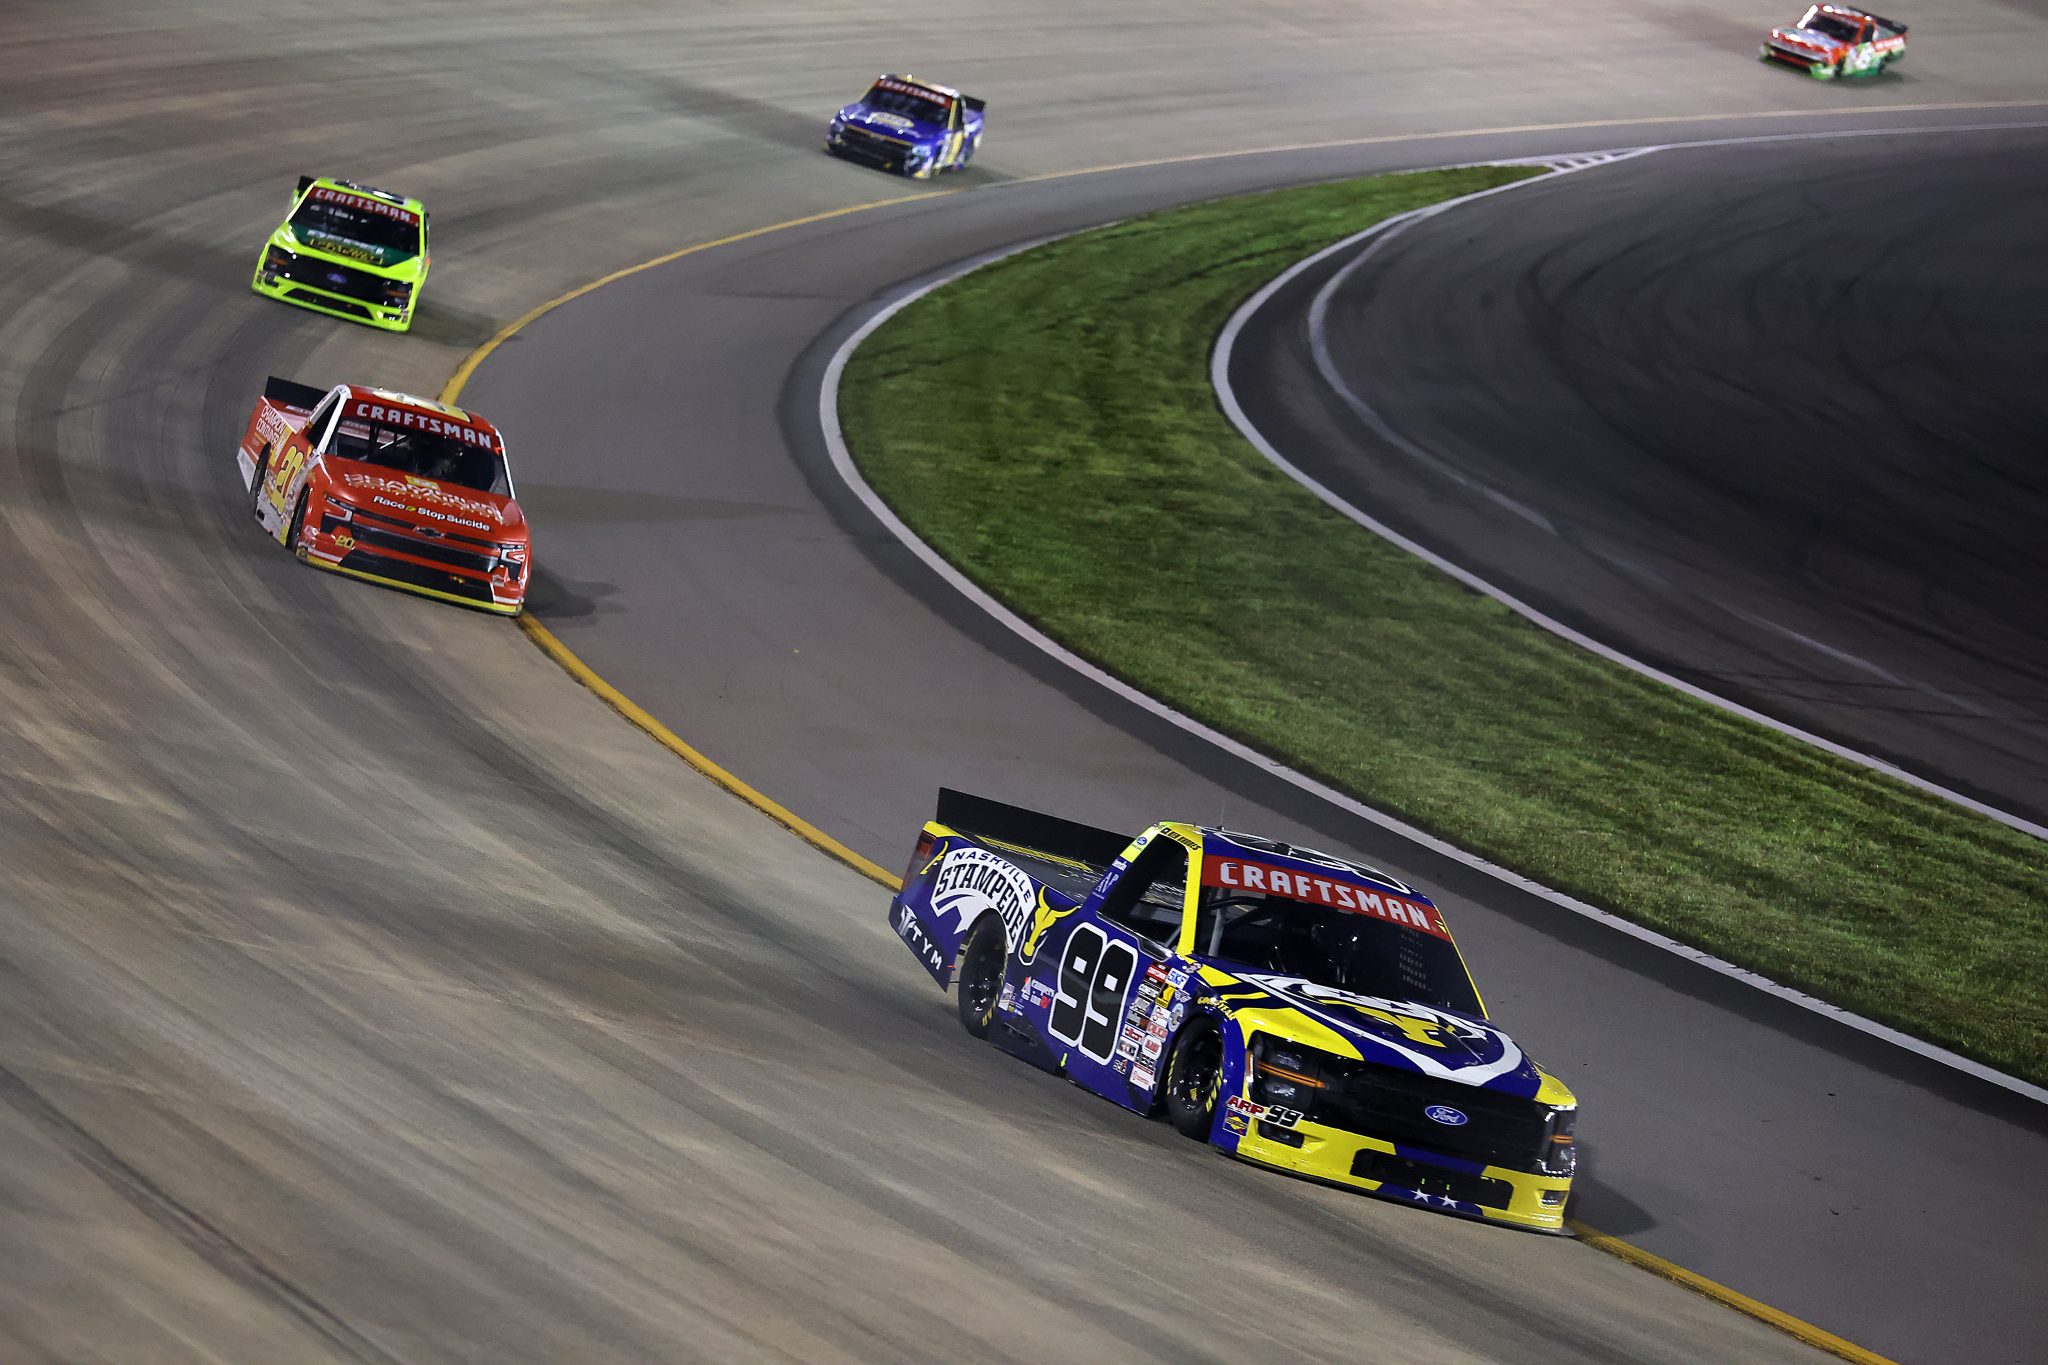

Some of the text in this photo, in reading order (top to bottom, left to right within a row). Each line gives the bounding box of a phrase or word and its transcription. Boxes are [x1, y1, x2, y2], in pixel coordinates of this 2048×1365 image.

[355, 403, 493, 449] CRAFTSMAN
[373, 495, 491, 532] Race Stop Suicide
[952, 850, 1032, 904] NASHVILLE
[1220, 862, 1429, 930] CRAFTSMAN
[935, 864, 1024, 940] STAMPEDE
[912, 926, 943, 972] TYM
[1047, 921, 1138, 1066] 99
[1167, 970, 1188, 986] SKF
[1227, 1096, 1265, 1115] ARP
[1265, 1105, 1304, 1129] 99
[1432, 1106, 1460, 1124] Ford
